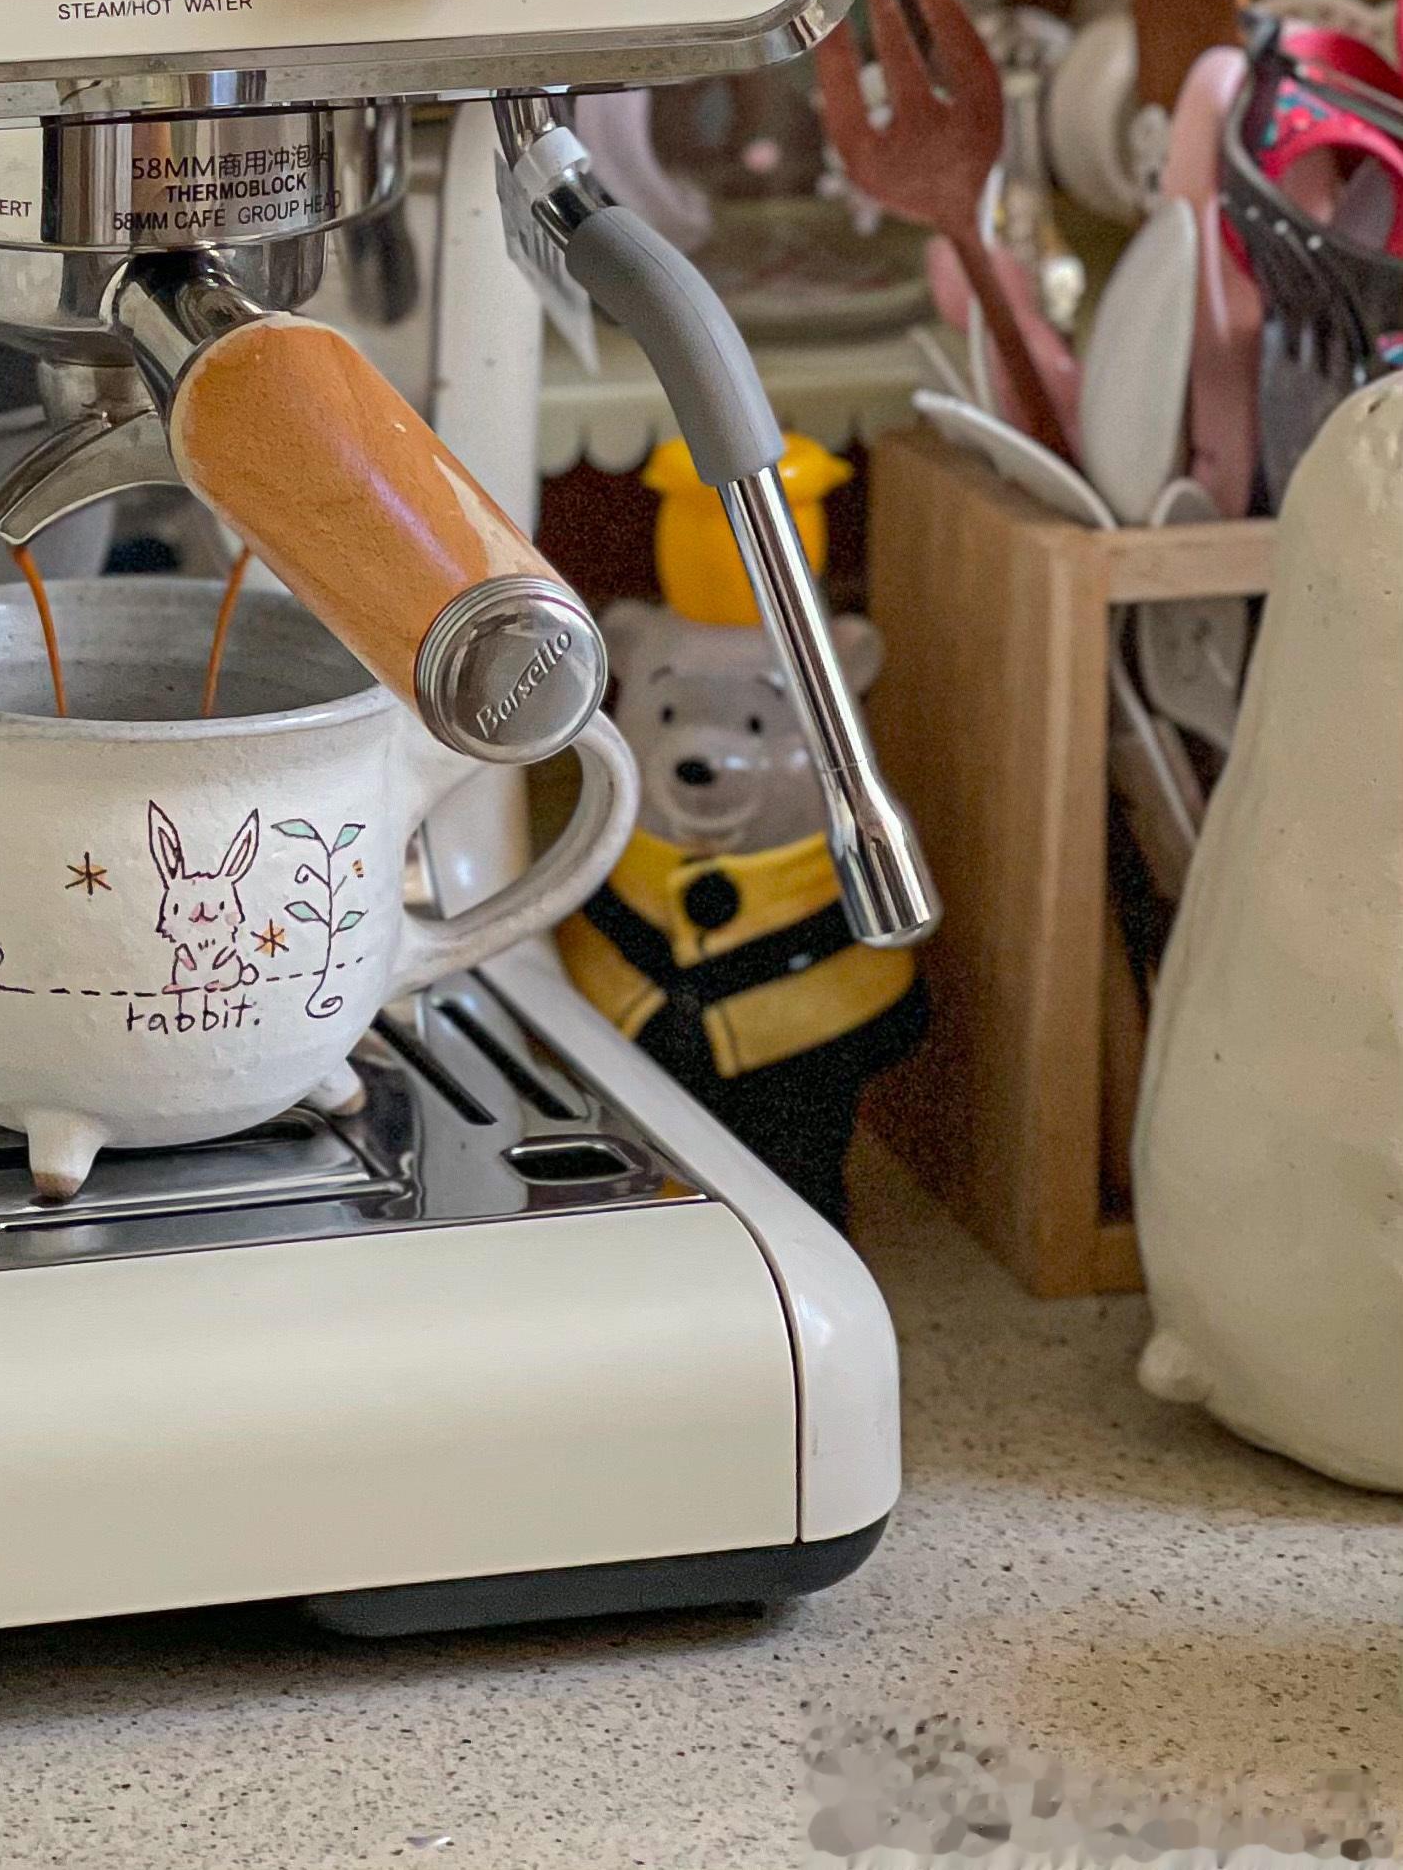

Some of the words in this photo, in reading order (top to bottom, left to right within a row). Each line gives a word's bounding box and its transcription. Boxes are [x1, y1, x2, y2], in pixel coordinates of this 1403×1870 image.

[165, 172, 308, 204] THERMOBLOCK
[112, 210, 169, 231] 58MM
[237, 199, 300, 225] GROUP
[302, 189, 342, 215] HEAD
[475, 630, 572, 740] Barsetto
